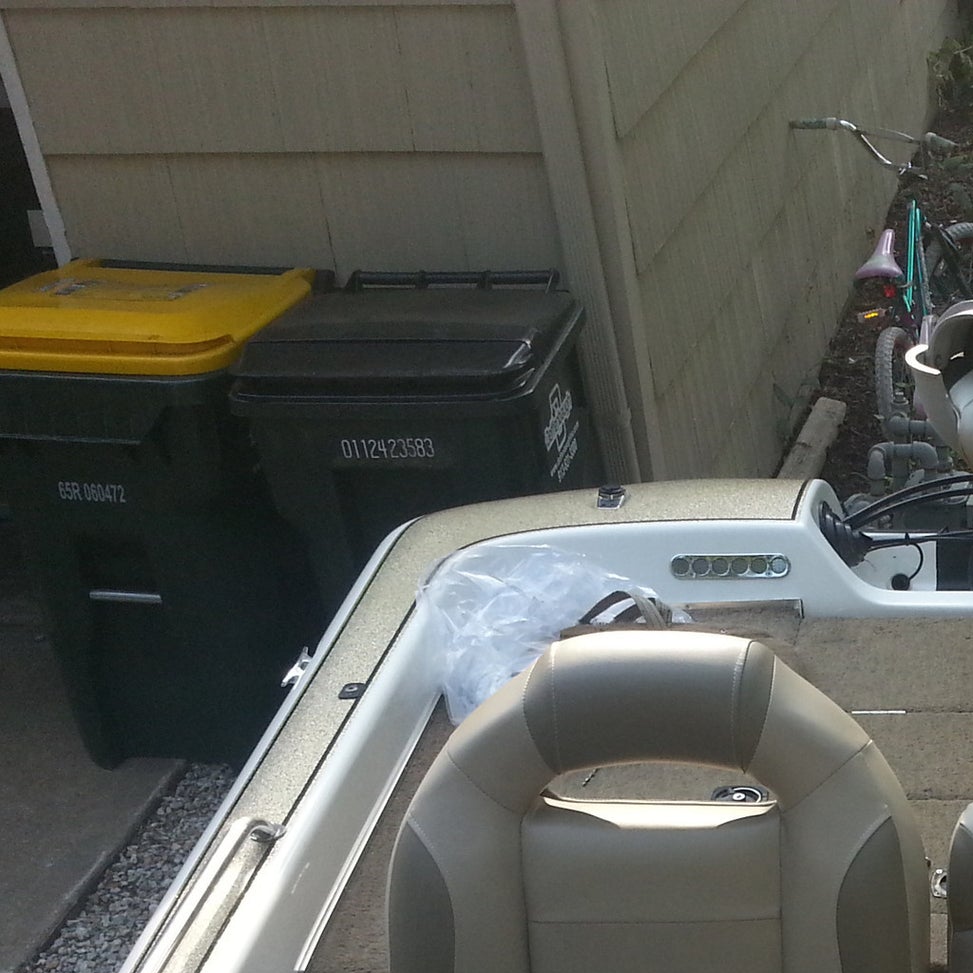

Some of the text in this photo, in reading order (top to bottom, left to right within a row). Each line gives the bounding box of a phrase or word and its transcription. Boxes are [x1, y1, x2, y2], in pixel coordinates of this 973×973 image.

[341, 438, 435, 459] 0112423583
[58, 481, 126, 503] 65R 060472
